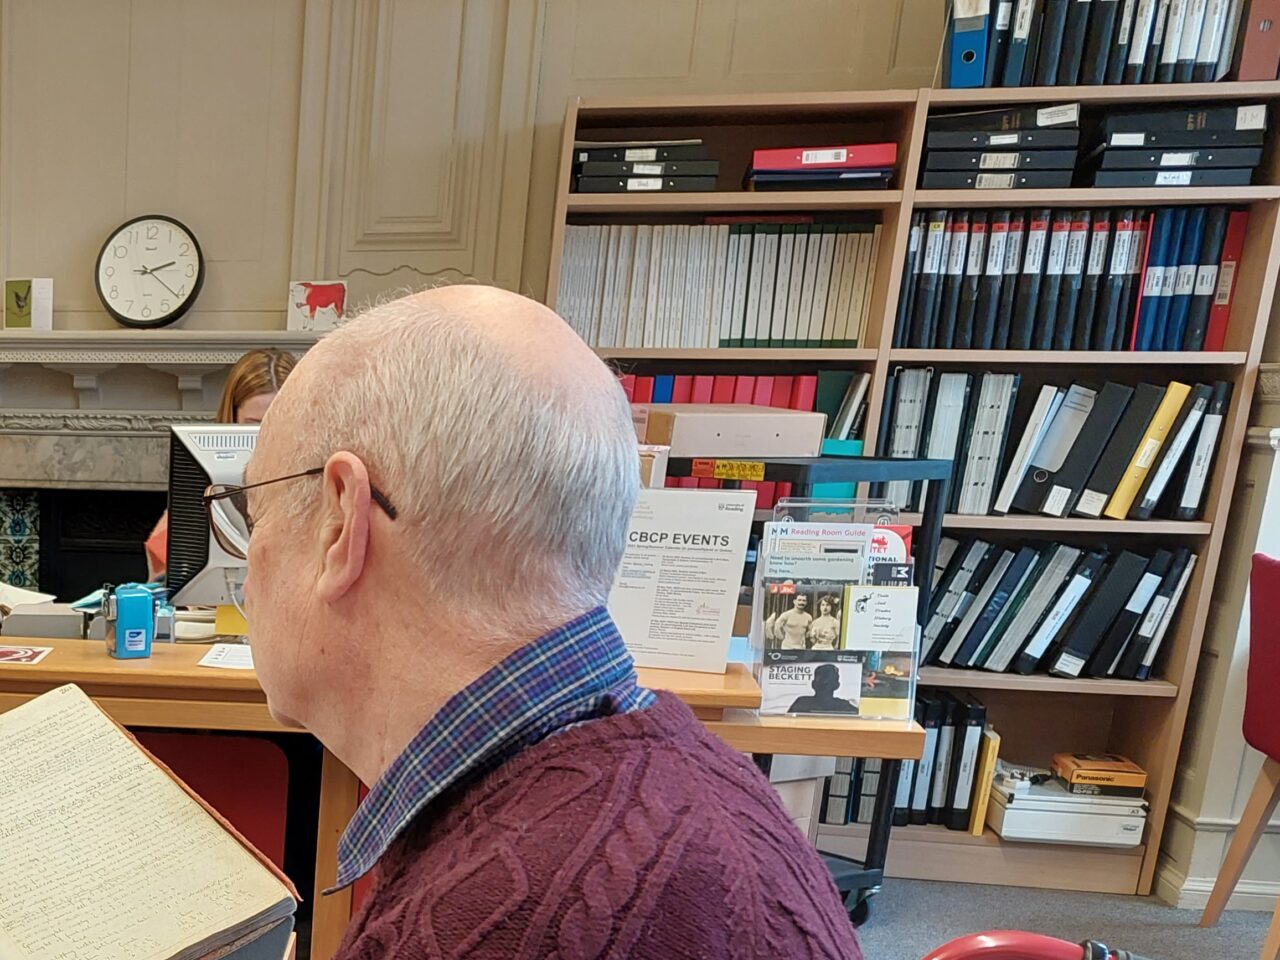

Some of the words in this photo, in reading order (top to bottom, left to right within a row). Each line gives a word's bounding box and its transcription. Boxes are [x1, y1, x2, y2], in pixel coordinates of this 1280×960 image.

[129, 231, 139, 244] 11
[147, 226, 159, 240] 12
[113, 245, 128, 259] 10
[179, 243, 190, 256] 2
[105, 266, 115, 280] 9
[185, 264, 195, 278] 3
[109, 285, 119, 300] 8
[177, 284, 186, 297] 4
[124, 300, 134, 313] 7
[141, 304, 152, 318] 6
[160, 300, 170, 313] 5
[629, 531, 669, 543] CBCP
[672, 533, 730, 546] EVENTS
[791, 528, 819, 537] Reading
[769, 665, 811, 673] STAGING
[768, 673, 813, 681] BECKETT
[1076, 774, 1116, 783] Panasonic
